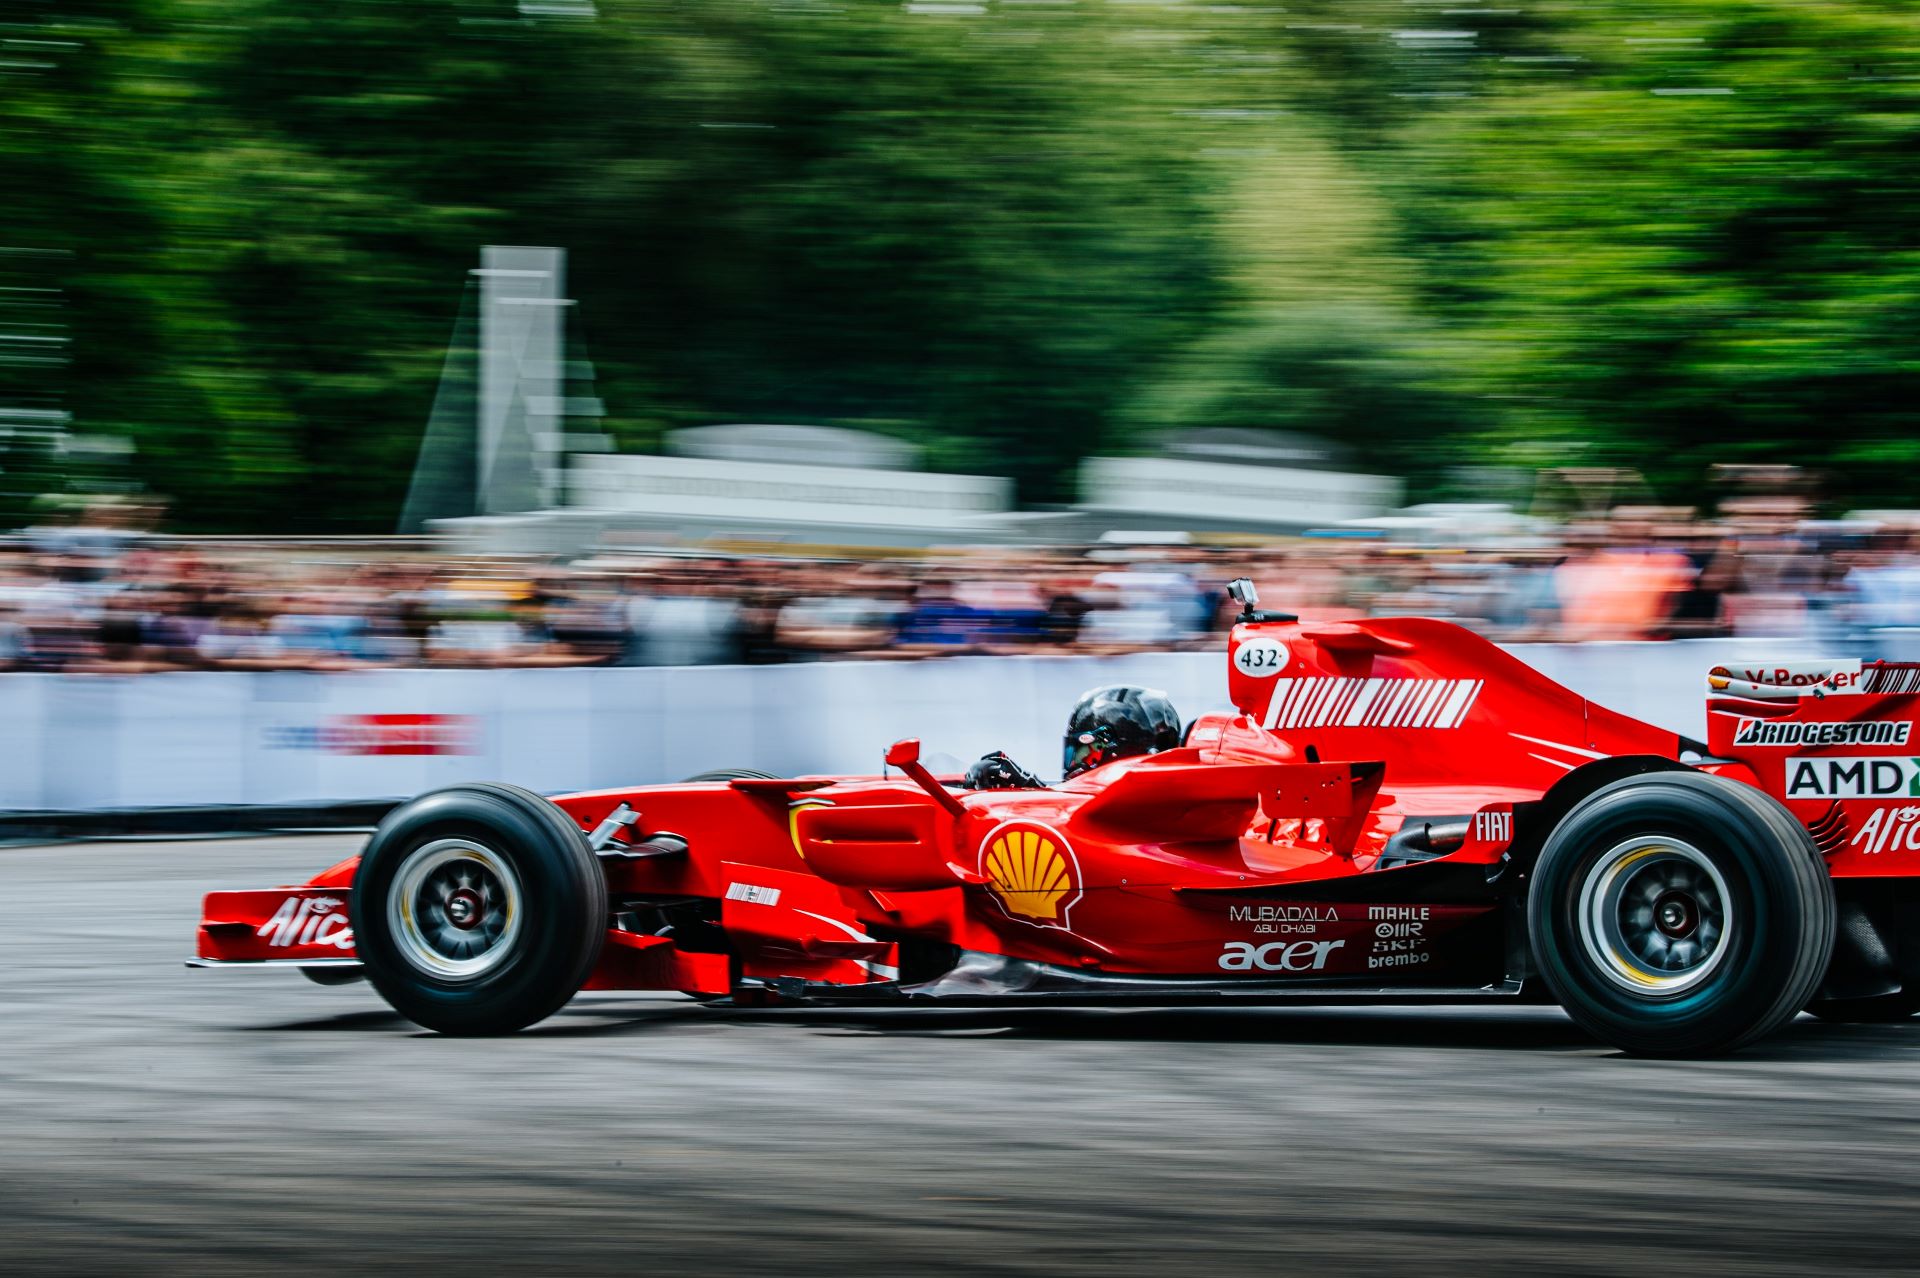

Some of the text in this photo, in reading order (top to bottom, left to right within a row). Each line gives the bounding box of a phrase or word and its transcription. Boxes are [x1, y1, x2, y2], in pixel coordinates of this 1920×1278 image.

[1241, 649, 1277, 667] 432
[1745, 668, 1860, 689] V-Power
[1735, 718, 1910, 745] BRIDGESTONE
[1788, 761, 1903, 795] AMD
[1476, 812, 1512, 841] FIAT
[1230, 906, 1339, 921] MUBADALA
[1369, 906, 1430, 920] MAHLE
[1254, 924, 1316, 933] ABU DHABI
[1373, 938, 1426, 952] SKF
[1218, 940, 1346, 970] acer
[1369, 952, 1430, 968] brembo
